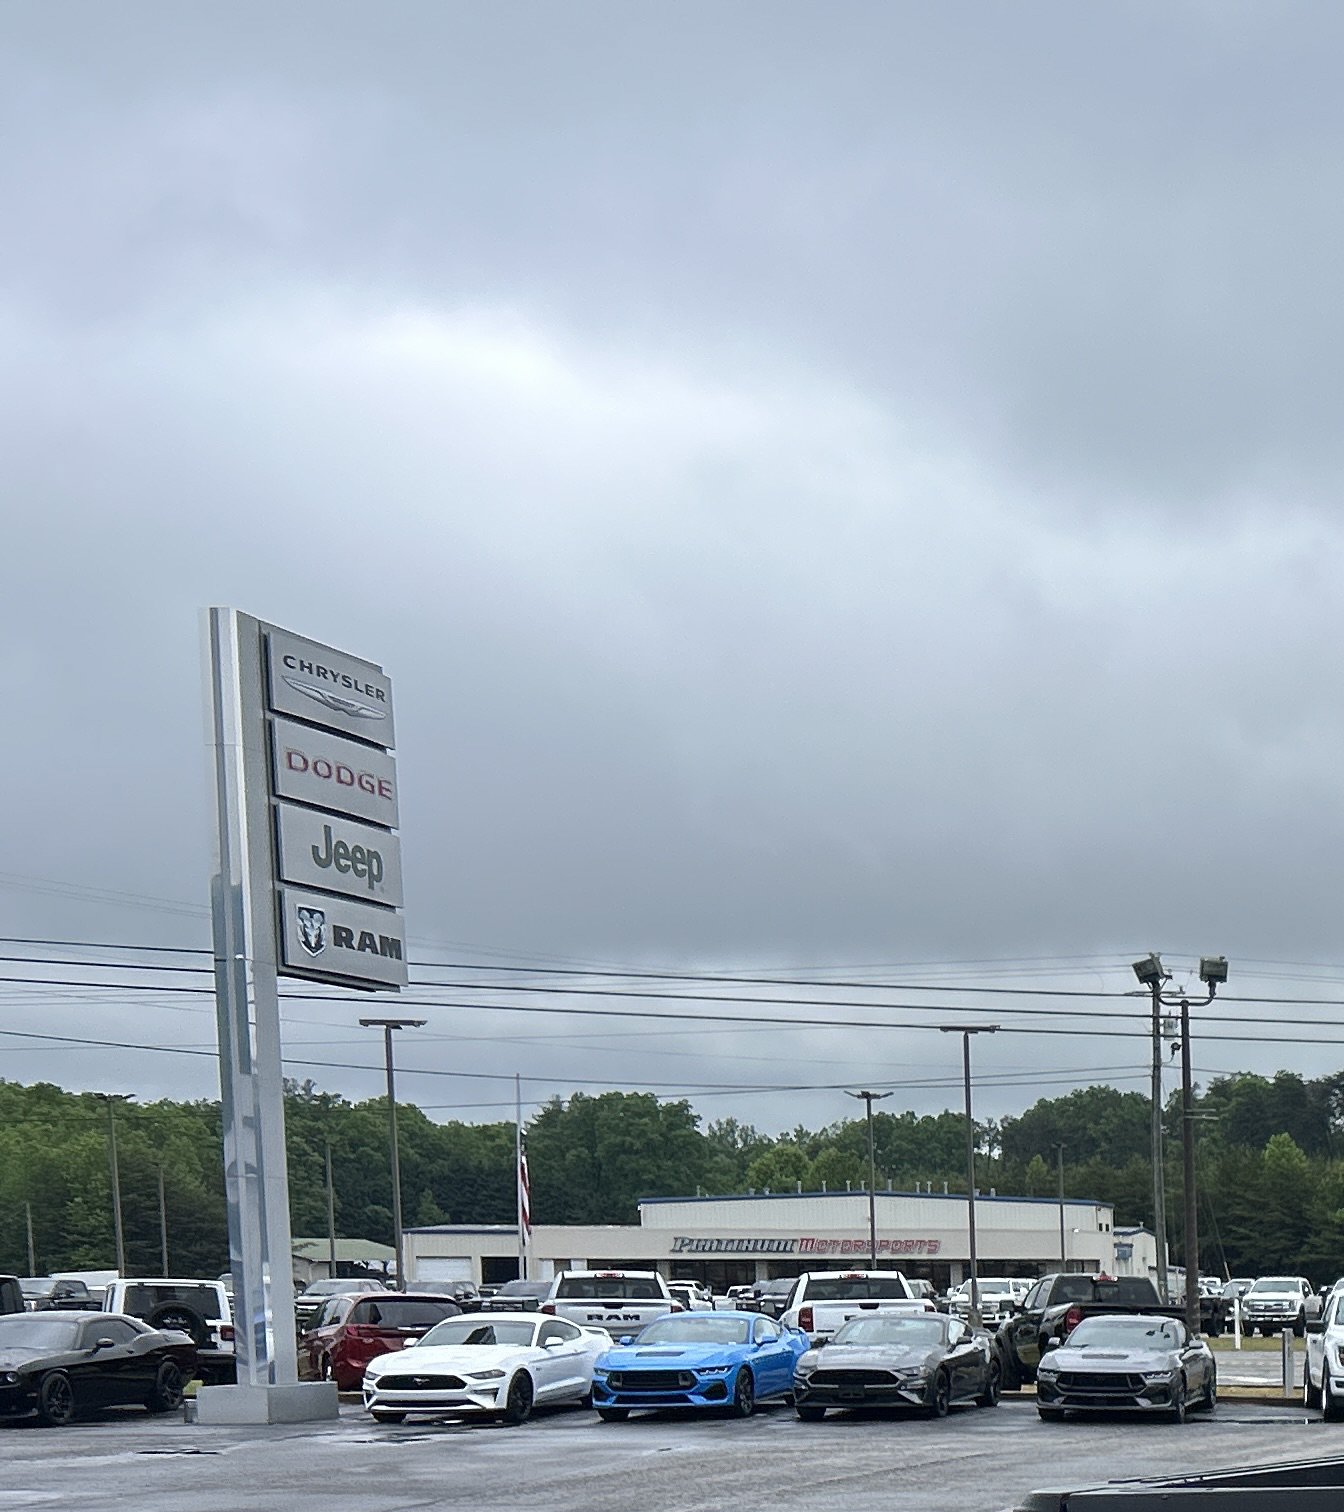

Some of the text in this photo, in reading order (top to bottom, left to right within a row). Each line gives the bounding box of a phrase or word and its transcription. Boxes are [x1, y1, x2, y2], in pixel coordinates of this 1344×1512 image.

[283, 655, 386, 703] CHRYSLER
[286, 750, 393, 800] DODGE
[312, 825, 383, 890] Jeep
[332, 925, 402, 960] RAM
